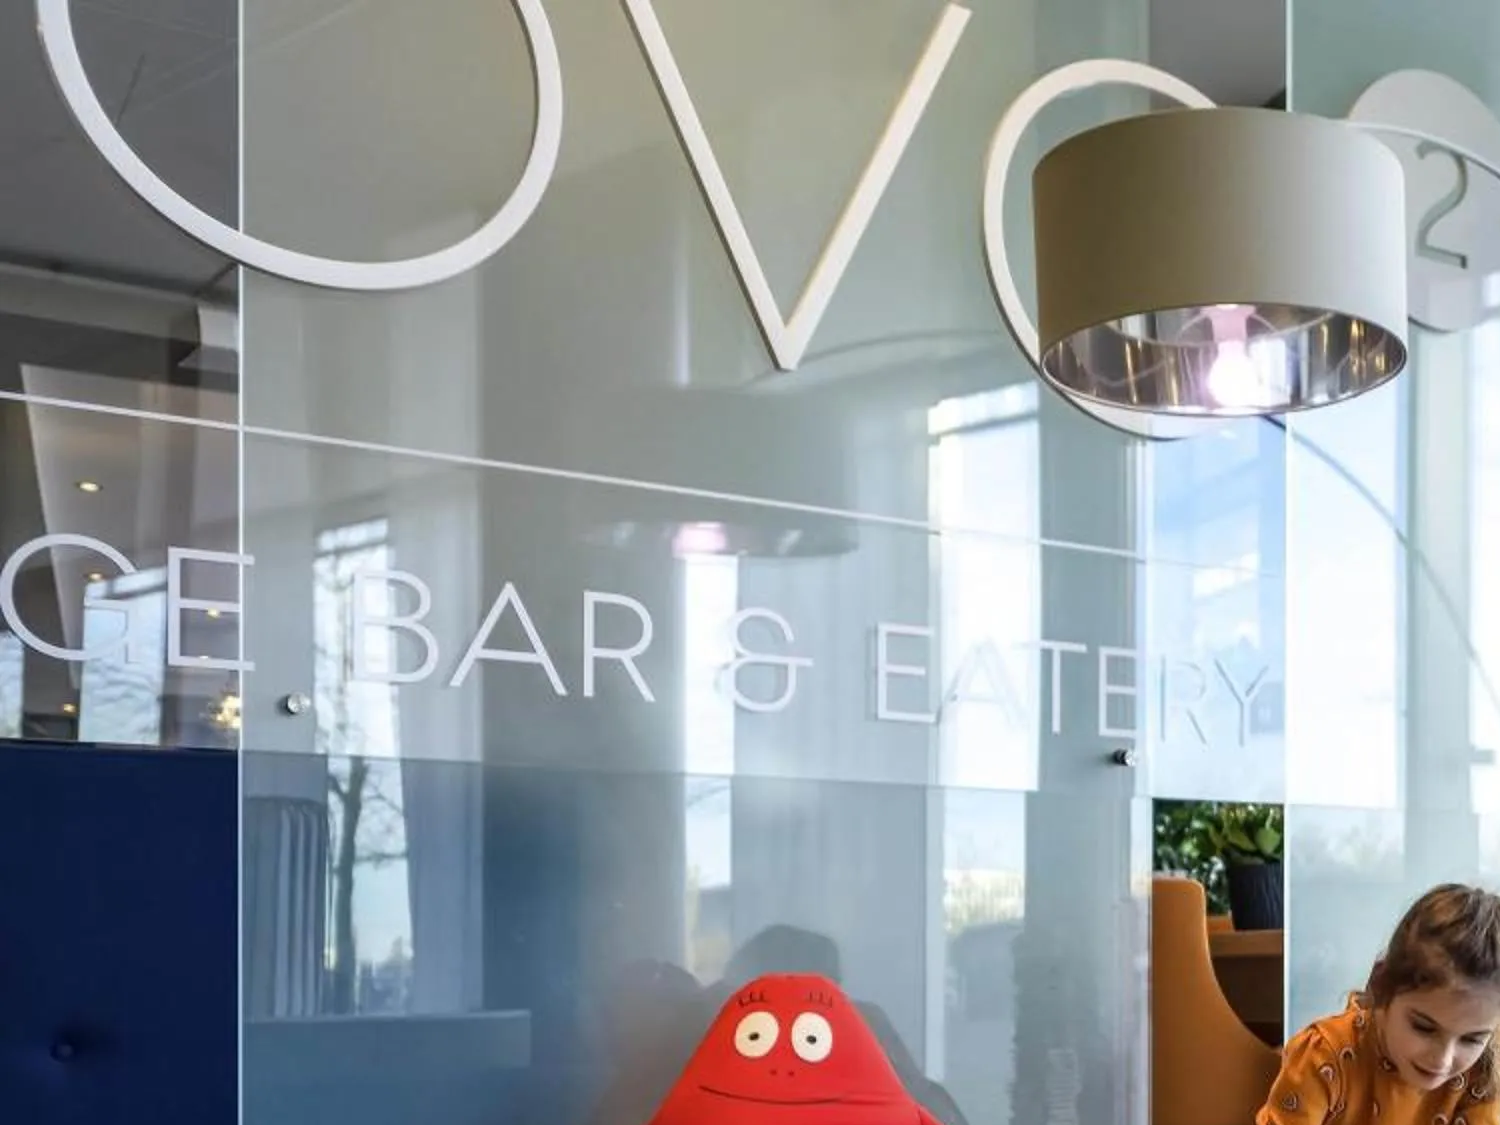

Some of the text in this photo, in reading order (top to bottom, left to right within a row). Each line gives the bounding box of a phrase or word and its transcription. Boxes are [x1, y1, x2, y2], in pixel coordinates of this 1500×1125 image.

[352, 569, 655, 703] BAR
[722, 608, 814, 712] &
[876, 621, 1269, 747] EATERY
